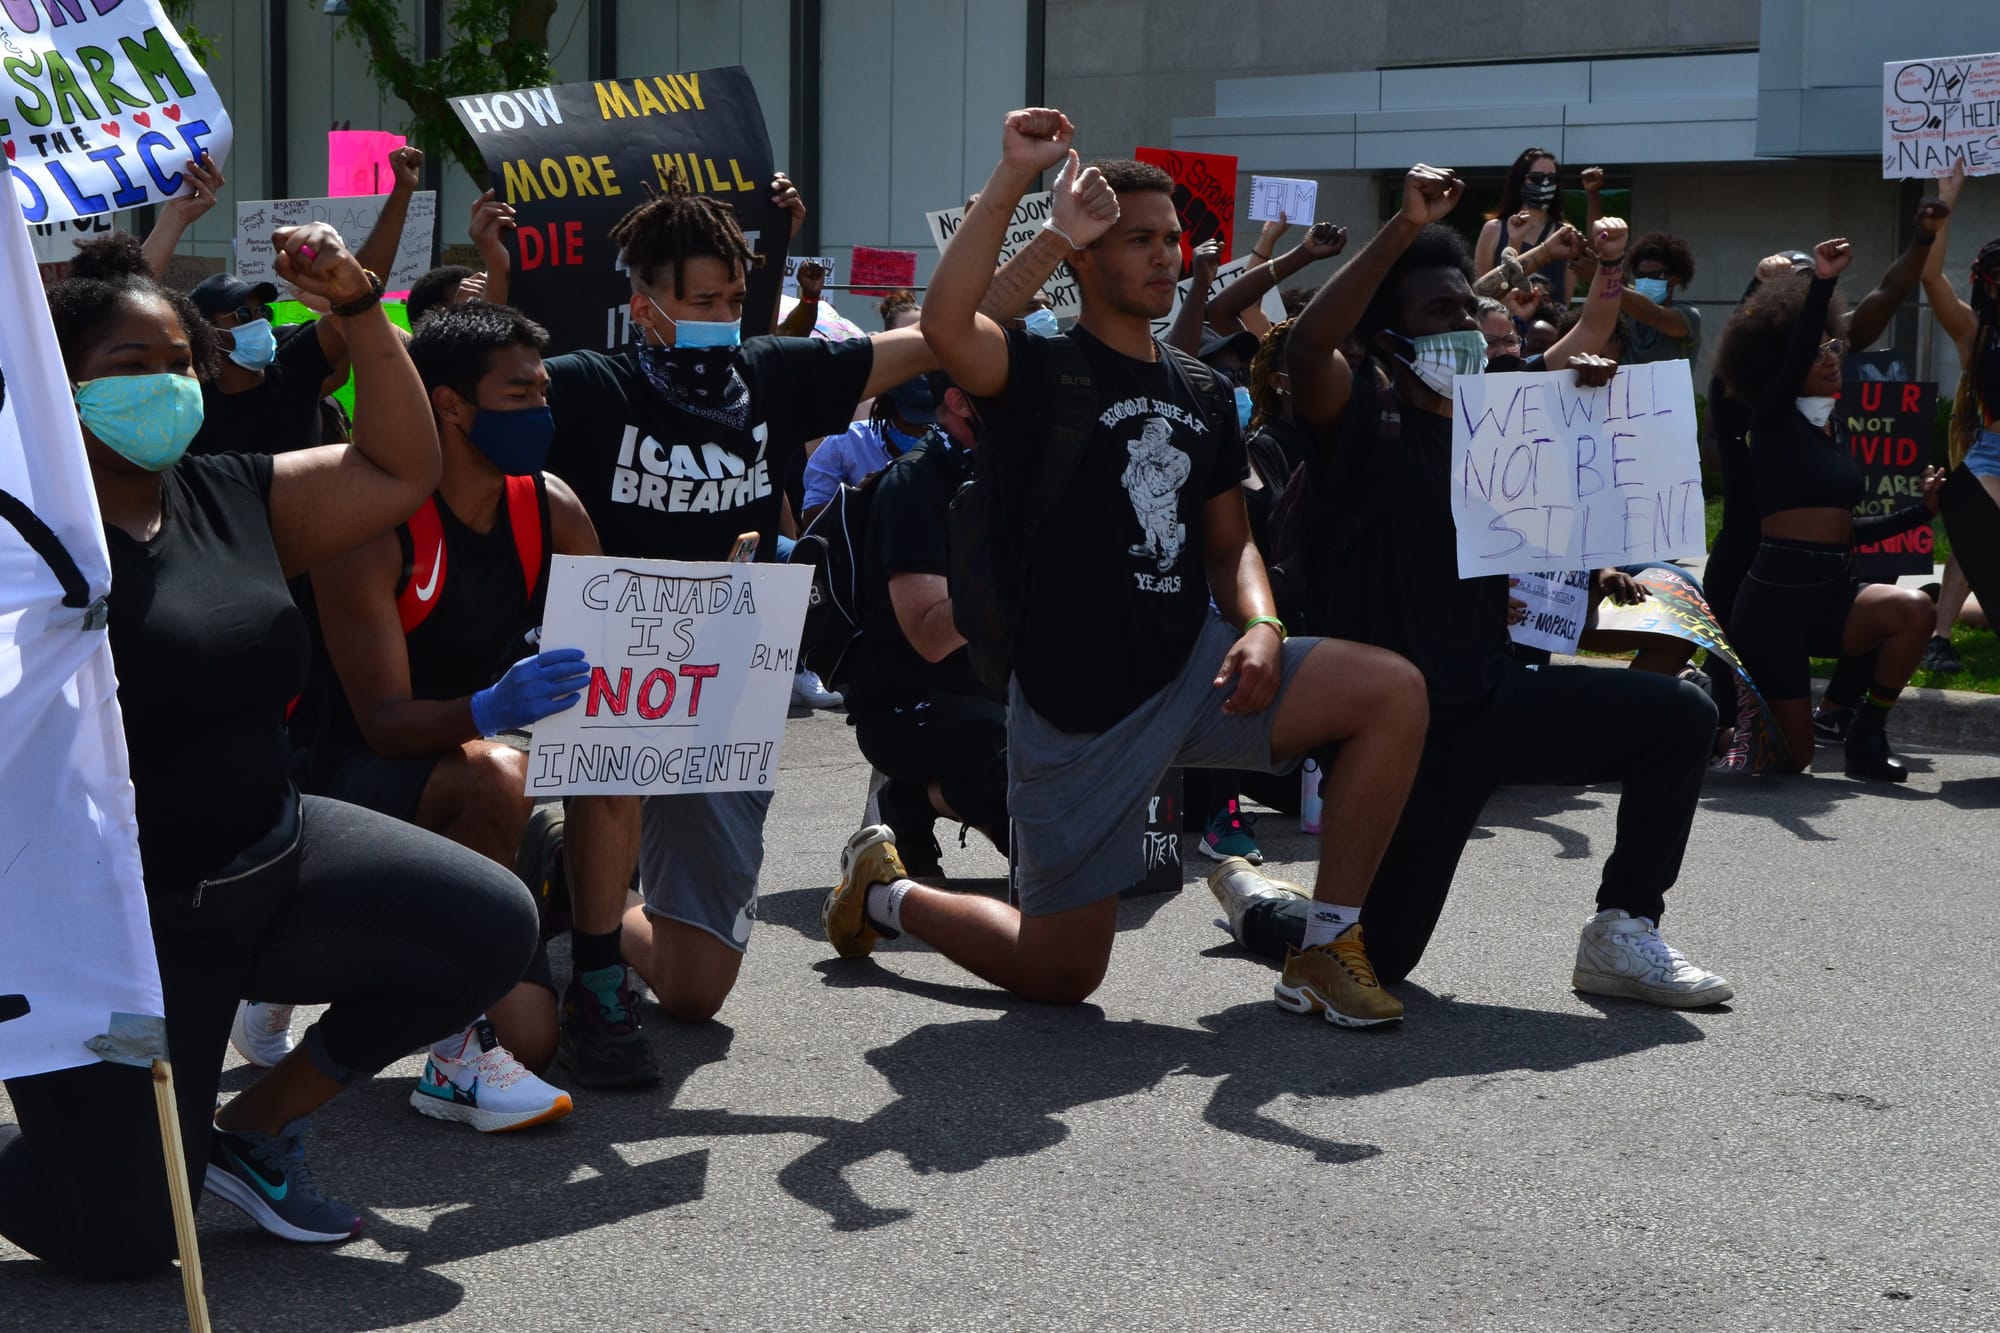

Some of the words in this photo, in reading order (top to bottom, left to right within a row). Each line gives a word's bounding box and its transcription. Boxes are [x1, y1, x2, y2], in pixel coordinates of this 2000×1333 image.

[0, 27, 196, 137] SARM
[459, 87, 564, 133] HOW
[594, 72, 705, 120] MANY
[29, 126, 91, 157] THE
[502, 155, 622, 205] MORE
[652, 153, 755, 194] WILL
[516, 221, 584, 271] DIE
[1012, 229, 1035, 243] are
[1460, 384, 1544, 440] WE
[1557, 366, 1672, 428] WILL
[1847, 416, 1896, 433] NOT
[617, 424, 640, 468] I
[1464, 437, 1555, 508] NOT
[1576, 431, 1644, 502] BE
[611, 459, 772, 514] BREATHE
[1876, 474, 1925, 497] ARE
[1480, 479, 1700, 569] SILENT
[582, 574, 756, 615] CANADA
[1134, 572, 1183, 594] YEARS
[627, 616, 696, 663] IS
[750, 643, 793, 672] BLM!
[584, 663, 720, 720] NOT
[533, 741, 774, 788] INNOCENT!
